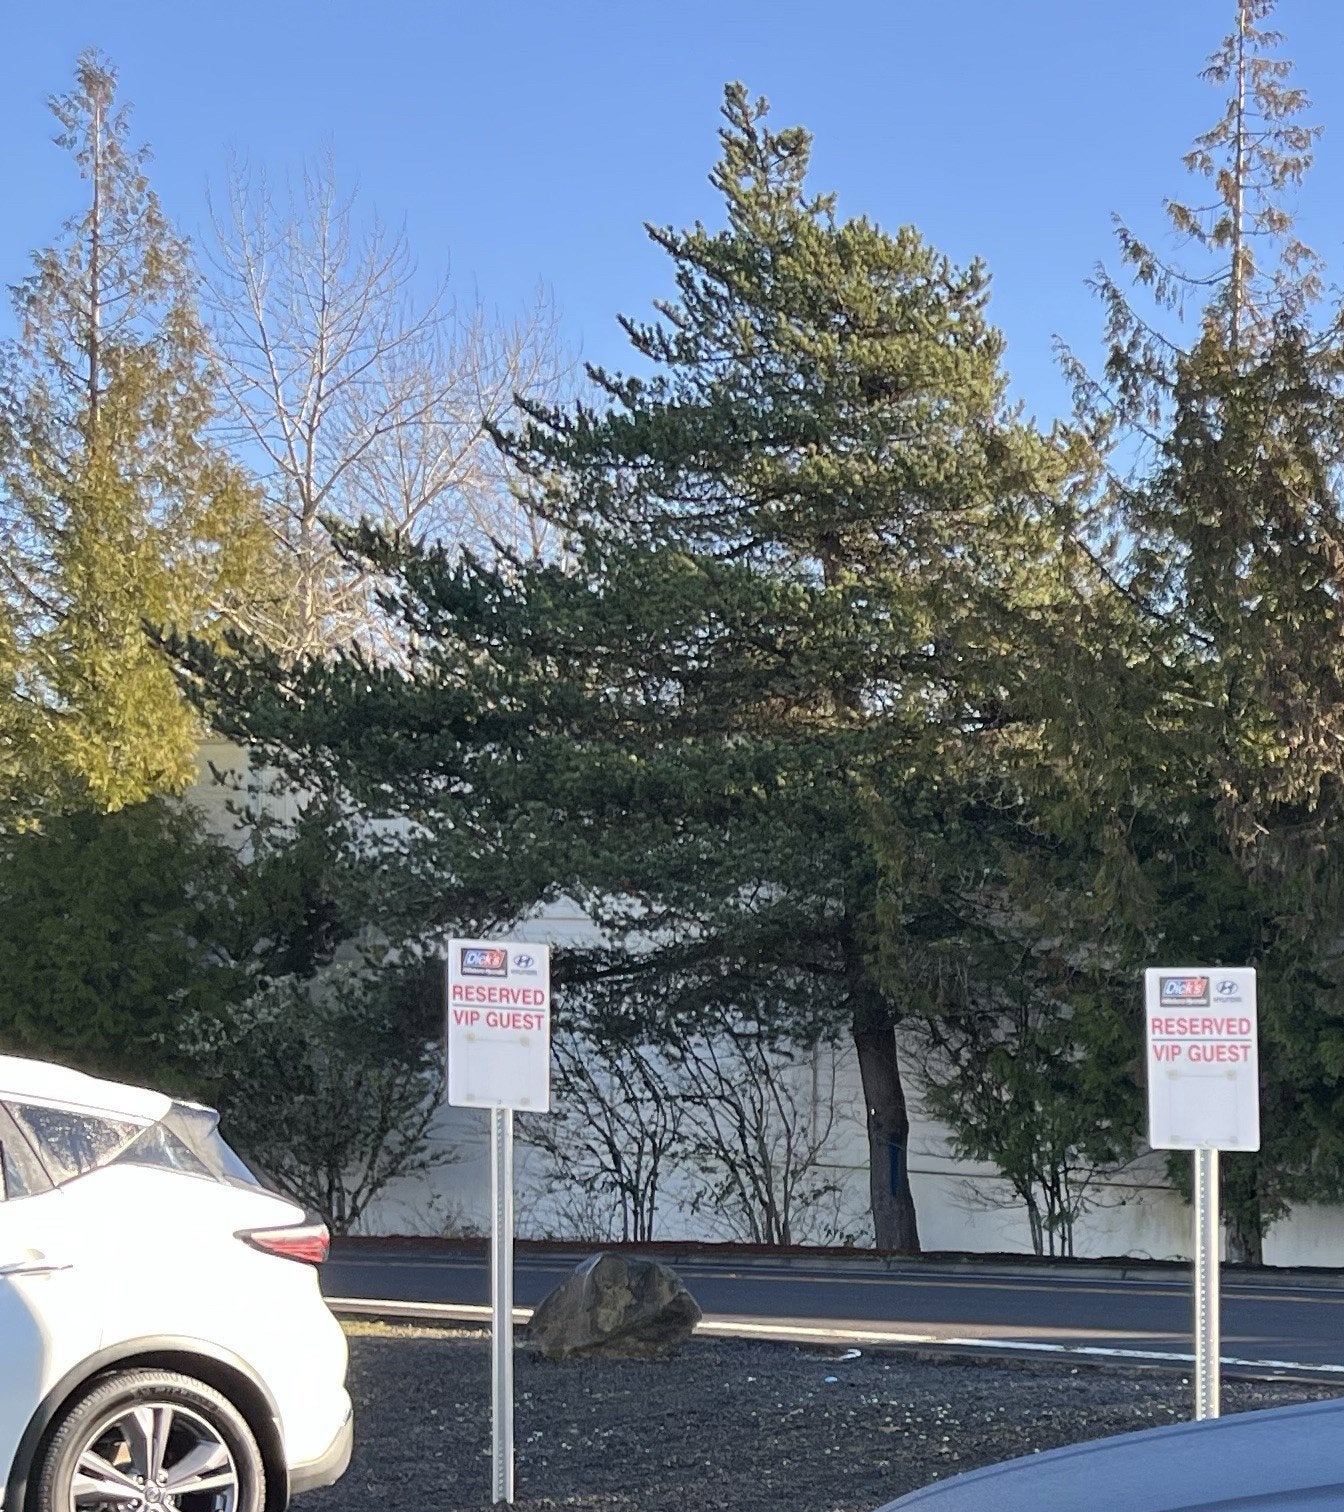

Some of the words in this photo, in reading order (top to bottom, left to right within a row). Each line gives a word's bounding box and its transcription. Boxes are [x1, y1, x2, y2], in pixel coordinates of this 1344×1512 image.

[452, 985, 545, 1005] RESERVED
[453, 1010, 480, 1025] VIP
[486, 1011, 545, 1031] GUEST
[1151, 1018, 1251, 1036] RESERVED
[1152, 1044, 1182, 1062] VIP
[1188, 1044, 1251, 1062] GUEST
